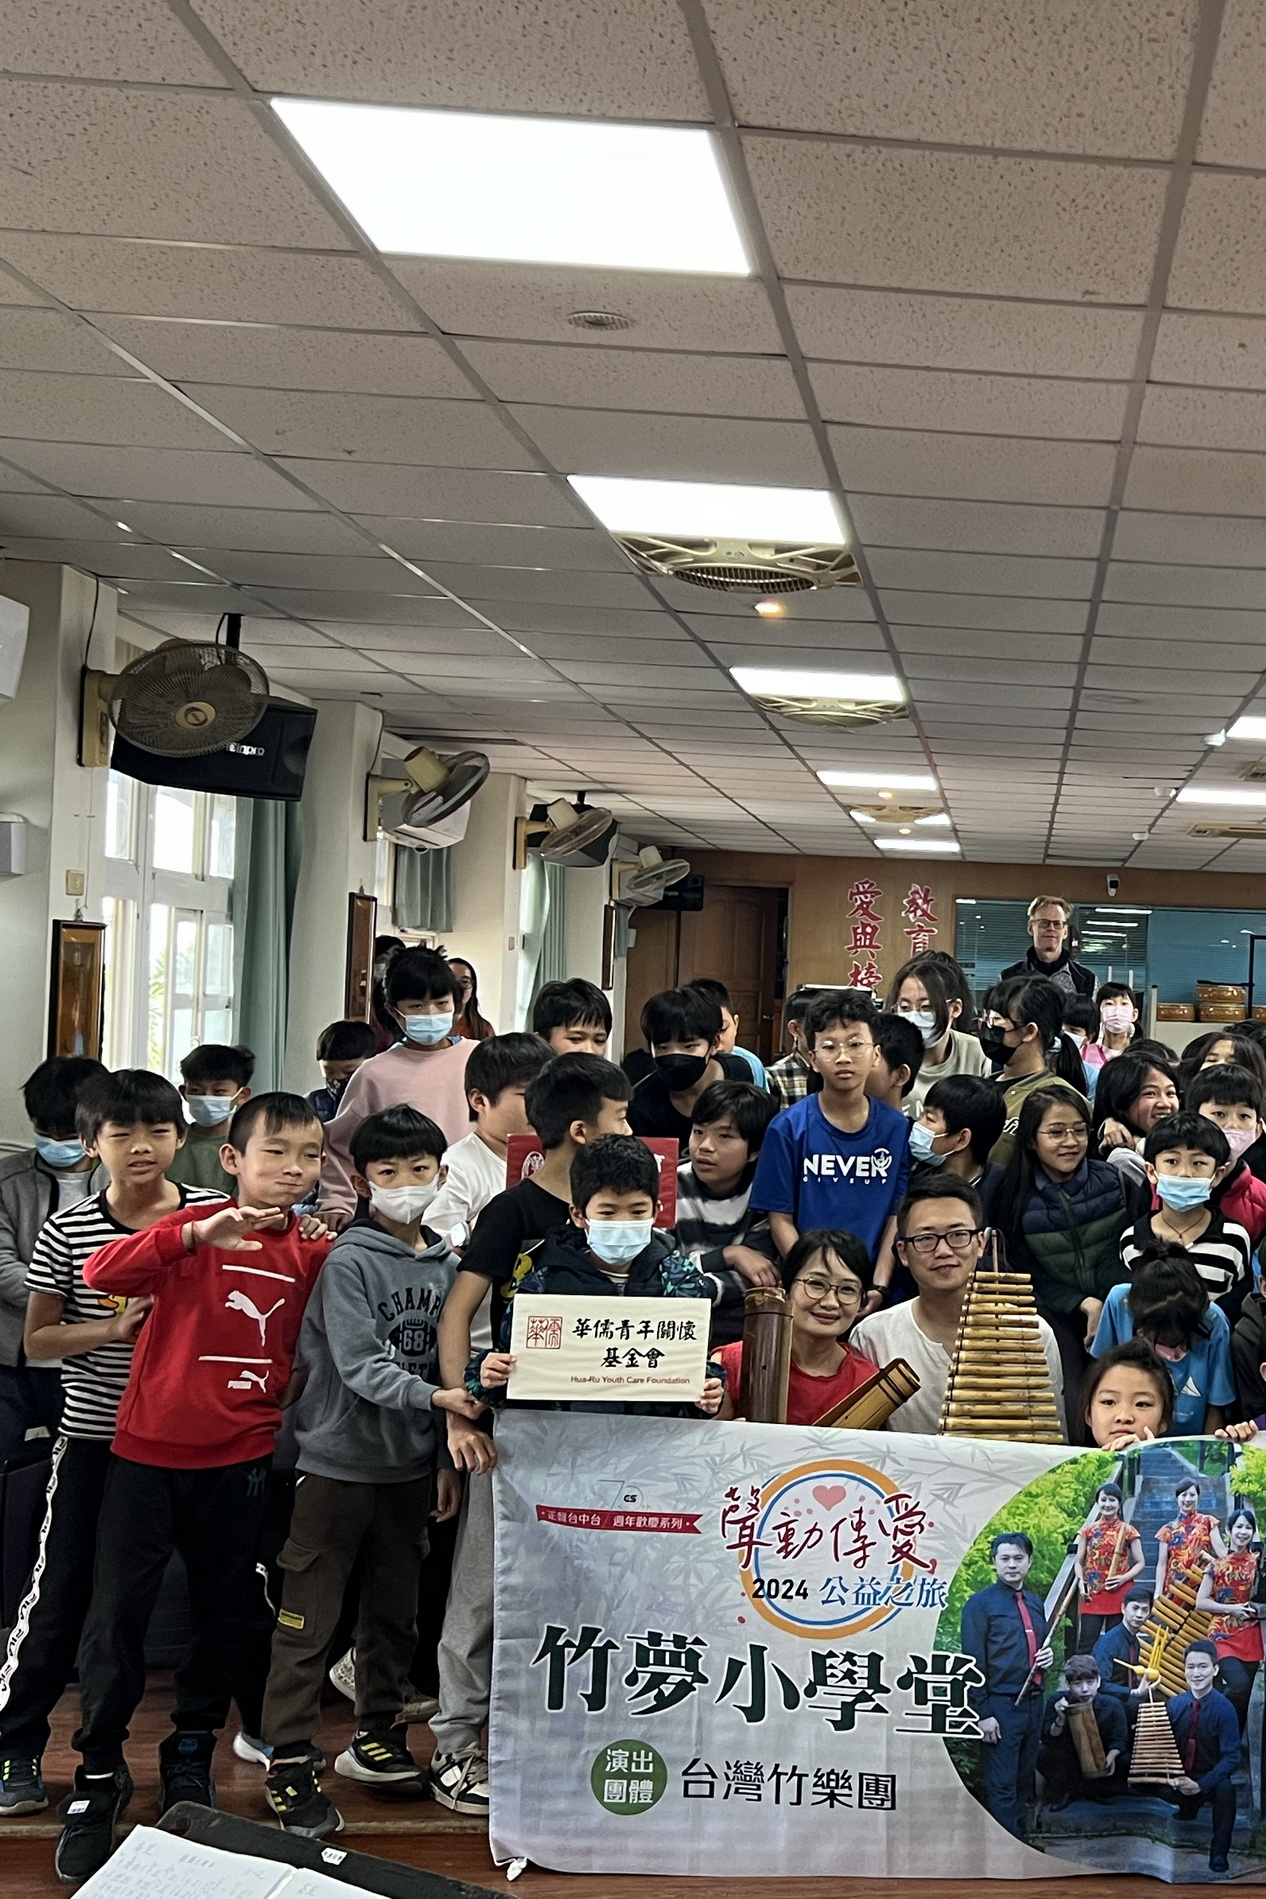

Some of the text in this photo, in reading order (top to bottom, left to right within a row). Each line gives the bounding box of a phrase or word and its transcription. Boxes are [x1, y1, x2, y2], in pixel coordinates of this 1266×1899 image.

[803, 1153, 892, 1178] NEVER
[403, 1329, 425, 1352] 68
[572, 1317, 698, 1341] 華儒青年關懷
[600, 1347, 665, 1369] 基金會
[570, 1375, 690, 1385] Hua-Ru Youth Care Foundation
[623, 1494, 637, 1503] CS
[547, 1510, 602, 1526] 正聲台中台
[612, 1515, 683, 1530] 週年歡慶系列
[720, 1485, 932, 1570] 聲動傳愛
[751, 1575, 949, 1610] 2024 公益之旅
[531, 1624, 986, 1739] 竹夢小學堂
[604, 1748, 654, 1773] 演出
[603, 1777, 654, 1804] 團體
[681, 1757, 898, 1811] 台灣竹樂團
